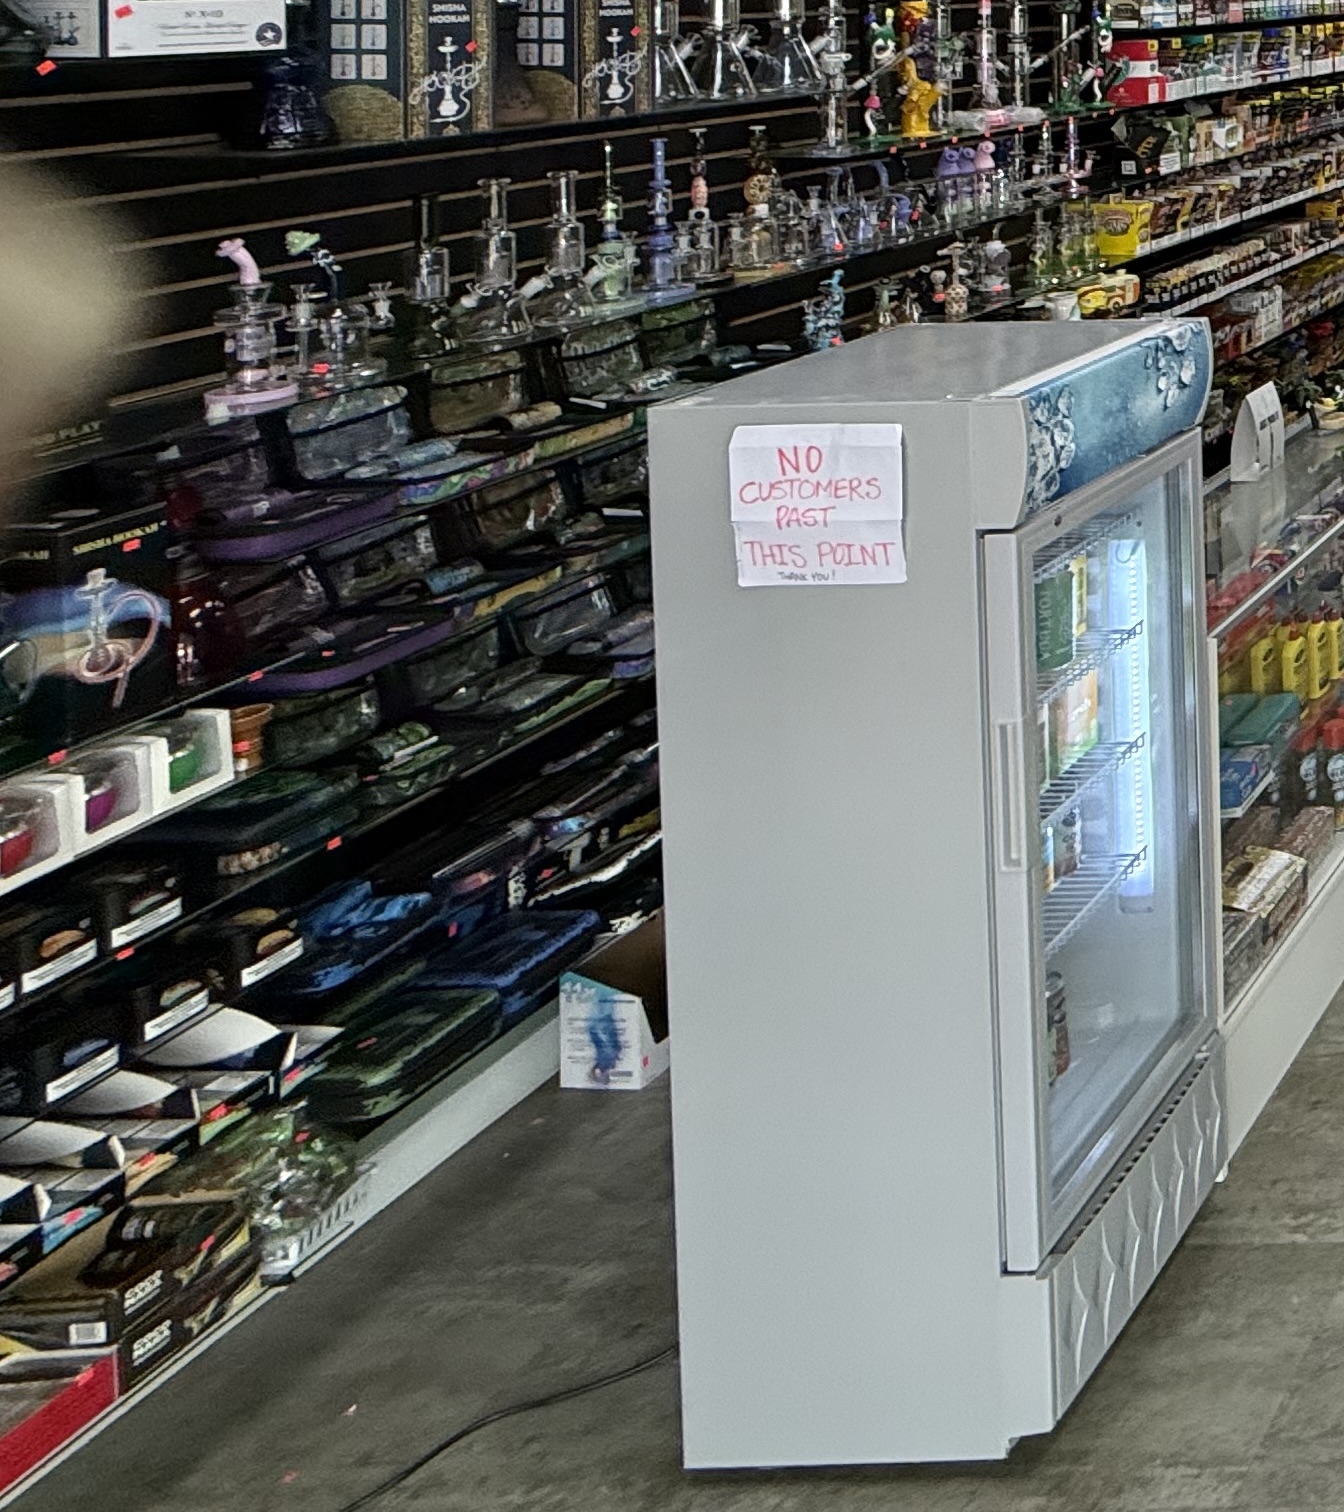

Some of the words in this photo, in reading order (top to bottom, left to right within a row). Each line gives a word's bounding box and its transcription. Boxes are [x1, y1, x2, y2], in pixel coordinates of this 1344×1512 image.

[428, 14, 471, 24] HOOKAH
[431, 3, 467, 14] SHISHA
[777, 445, 823, 476] NO
[739, 477, 882, 504] CUSTOMERS
[776, 505, 836, 530] PAST
[744, 541, 807, 568] THIS
[816, 541, 895, 567] POINT
[777, 570, 808, 581] THANK
[811, 569, 836, 581] YOU!
